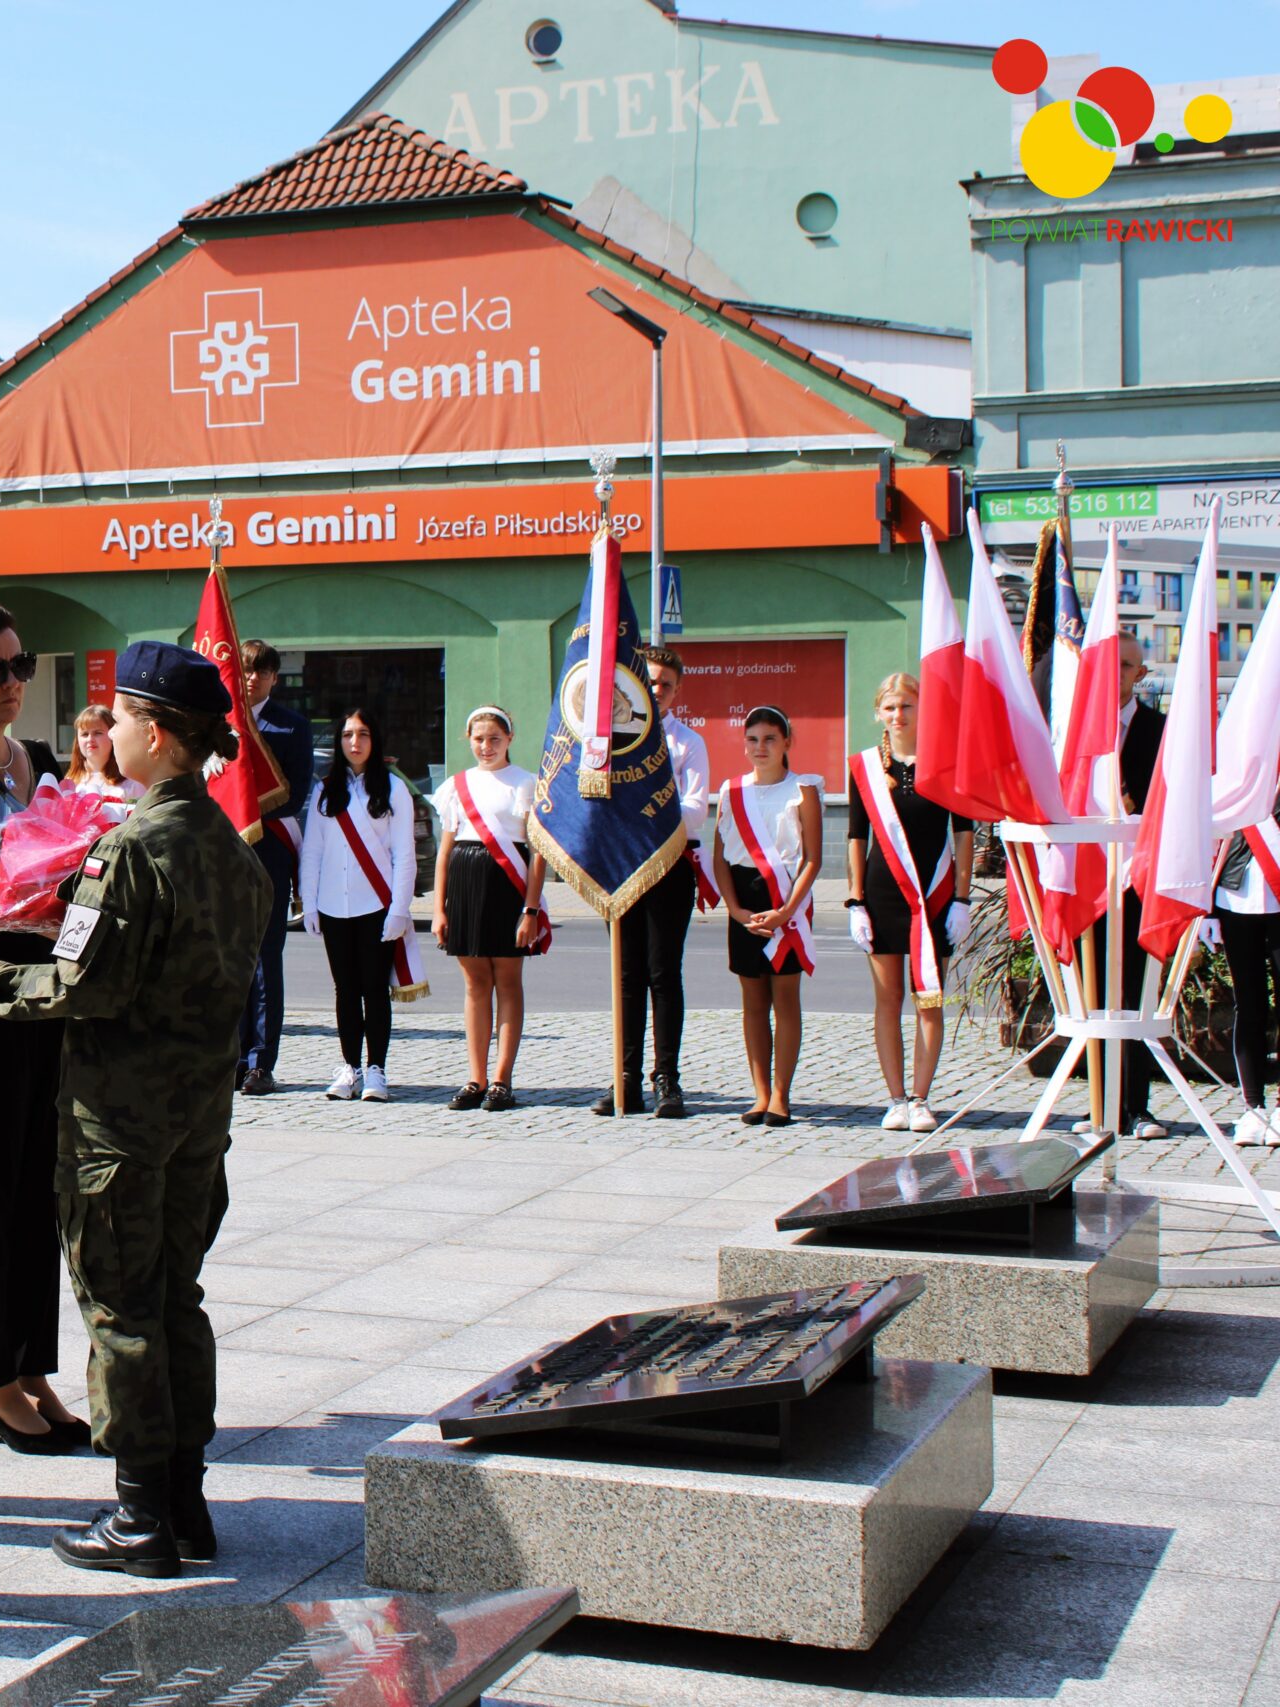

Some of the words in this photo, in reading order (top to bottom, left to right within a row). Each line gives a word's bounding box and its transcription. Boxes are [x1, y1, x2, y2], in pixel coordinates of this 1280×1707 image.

[442, 61, 780, 152] APTEKA
[347, 286, 512, 352] Apteka
[351, 346, 541, 404] Gemini
[101, 513, 235, 561] Apteka
[247, 504, 397, 546] Gemini
[416, 515, 488, 544] Józefa
[494, 510, 642, 538] Piłsudskigo
[989, 499, 1018, 516] tel.
[1070, 494, 1108, 513] 516
[1114, 492, 1152, 511] 112
[682, 664, 721, 675] twarta
[736, 662, 797, 677] godzinach:
